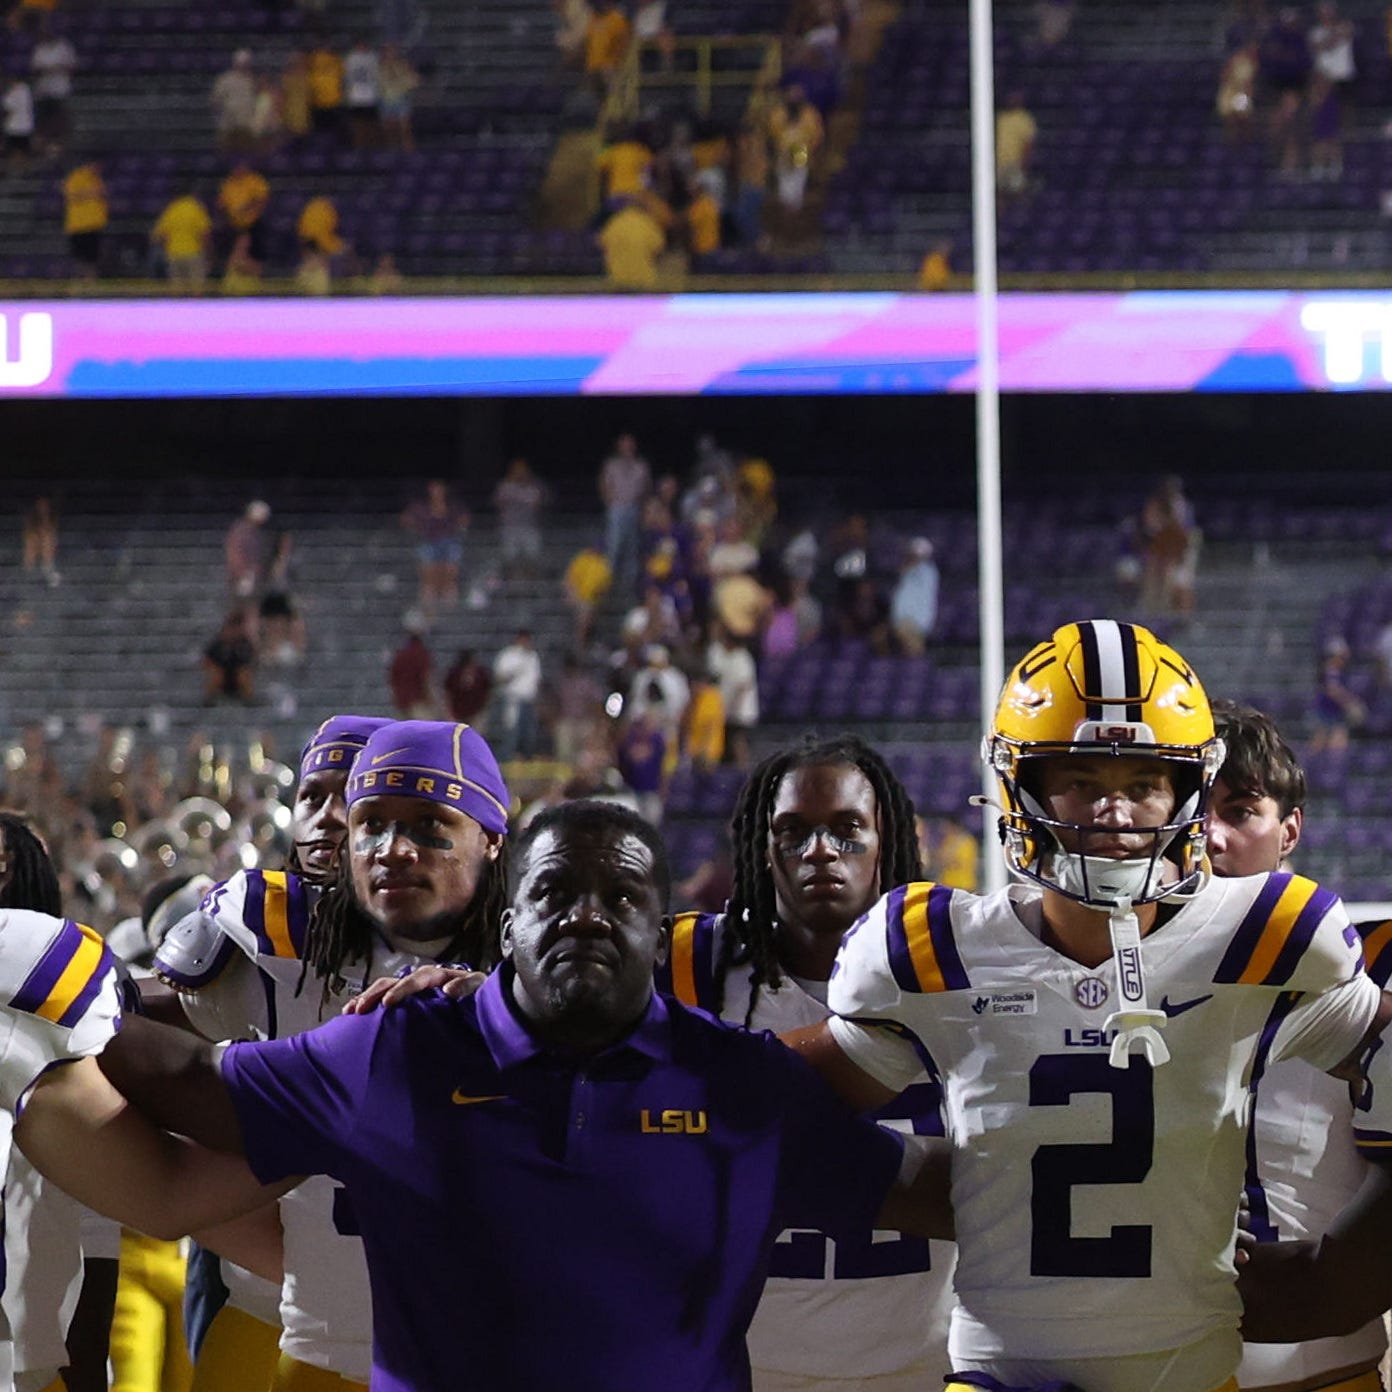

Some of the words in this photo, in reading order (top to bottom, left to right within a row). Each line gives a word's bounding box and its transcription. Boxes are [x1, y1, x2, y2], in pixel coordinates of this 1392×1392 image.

[1064, 1028, 1121, 1047] LSU
[641, 1109, 708, 1134] LSU
[1029, 1053, 1154, 1277] 2
